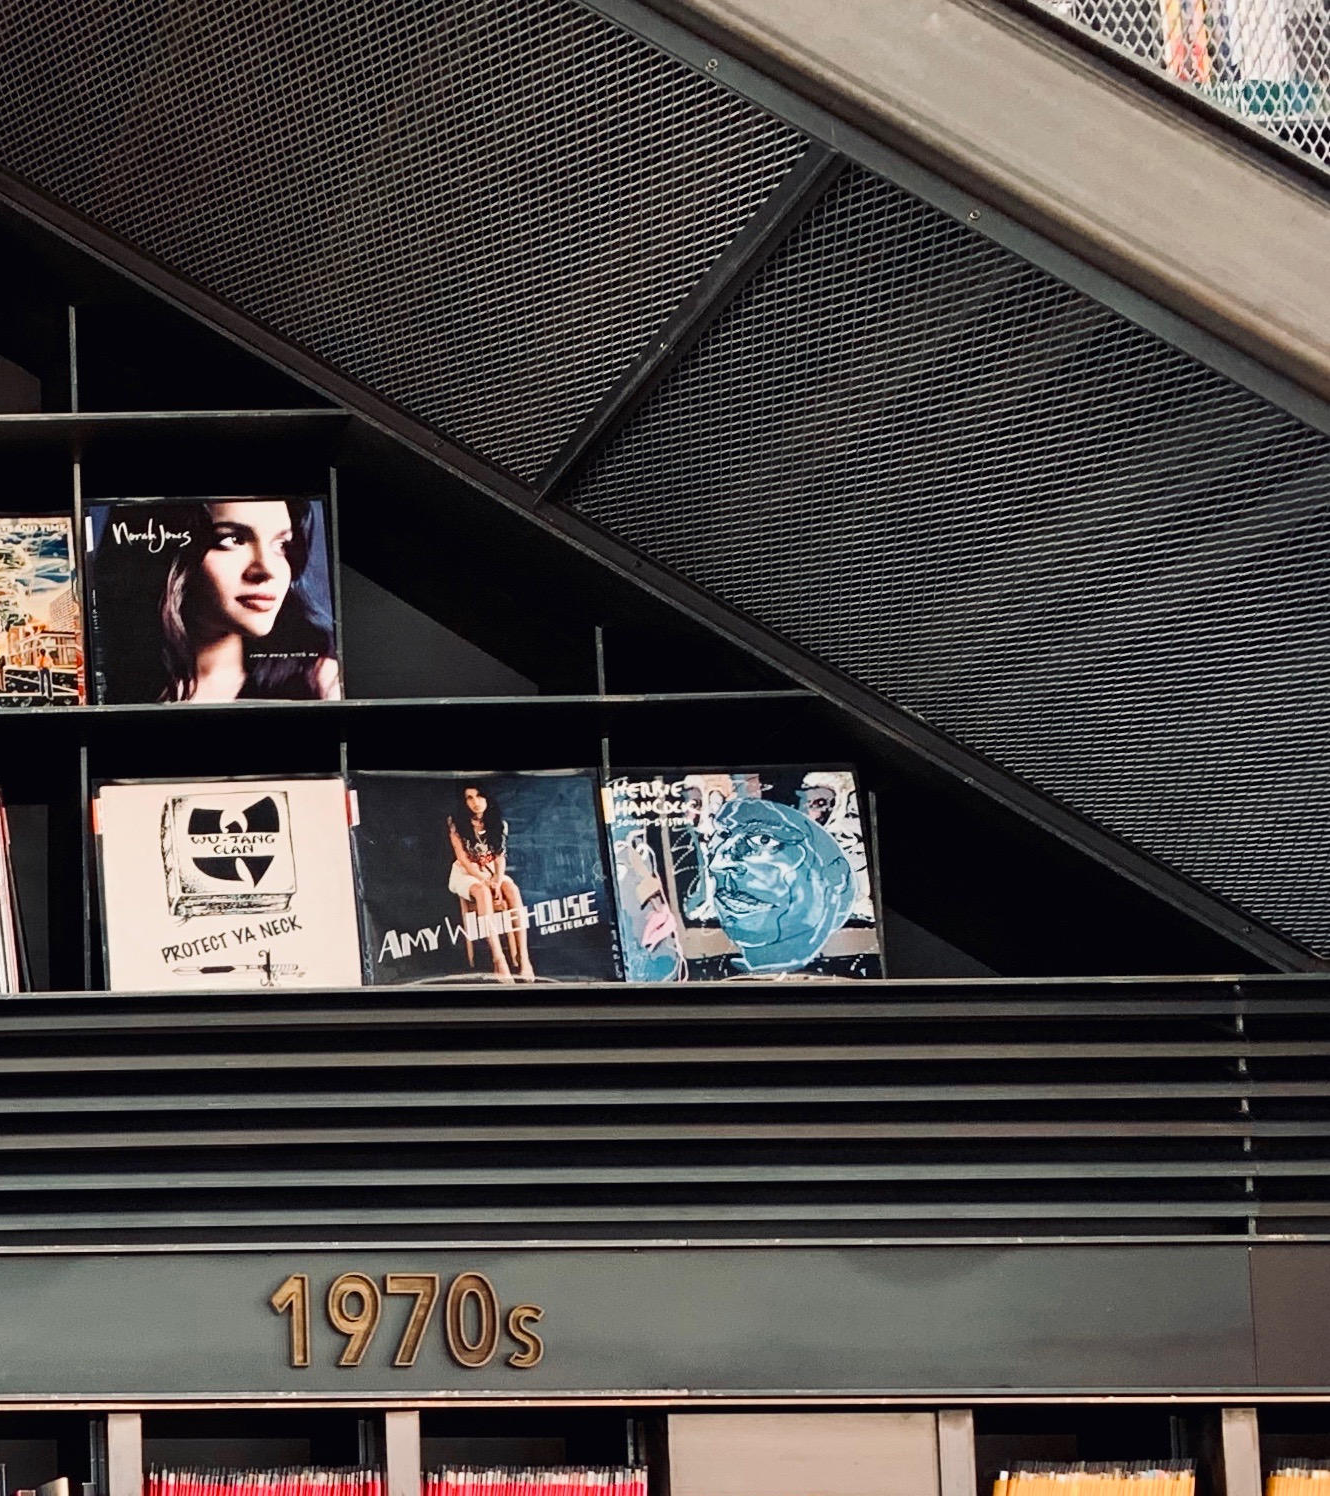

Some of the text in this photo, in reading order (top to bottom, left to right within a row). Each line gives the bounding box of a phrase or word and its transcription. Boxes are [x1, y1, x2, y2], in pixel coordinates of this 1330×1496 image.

[190, 835, 276, 845] WU-TANG
[213, 844, 254, 855] CLAN
[161, 915, 302, 964] PROTECT YA NECK
[378, 890, 597, 964] AMY WINEHOUSE
[271, 1272, 545, 1368] 1970s
